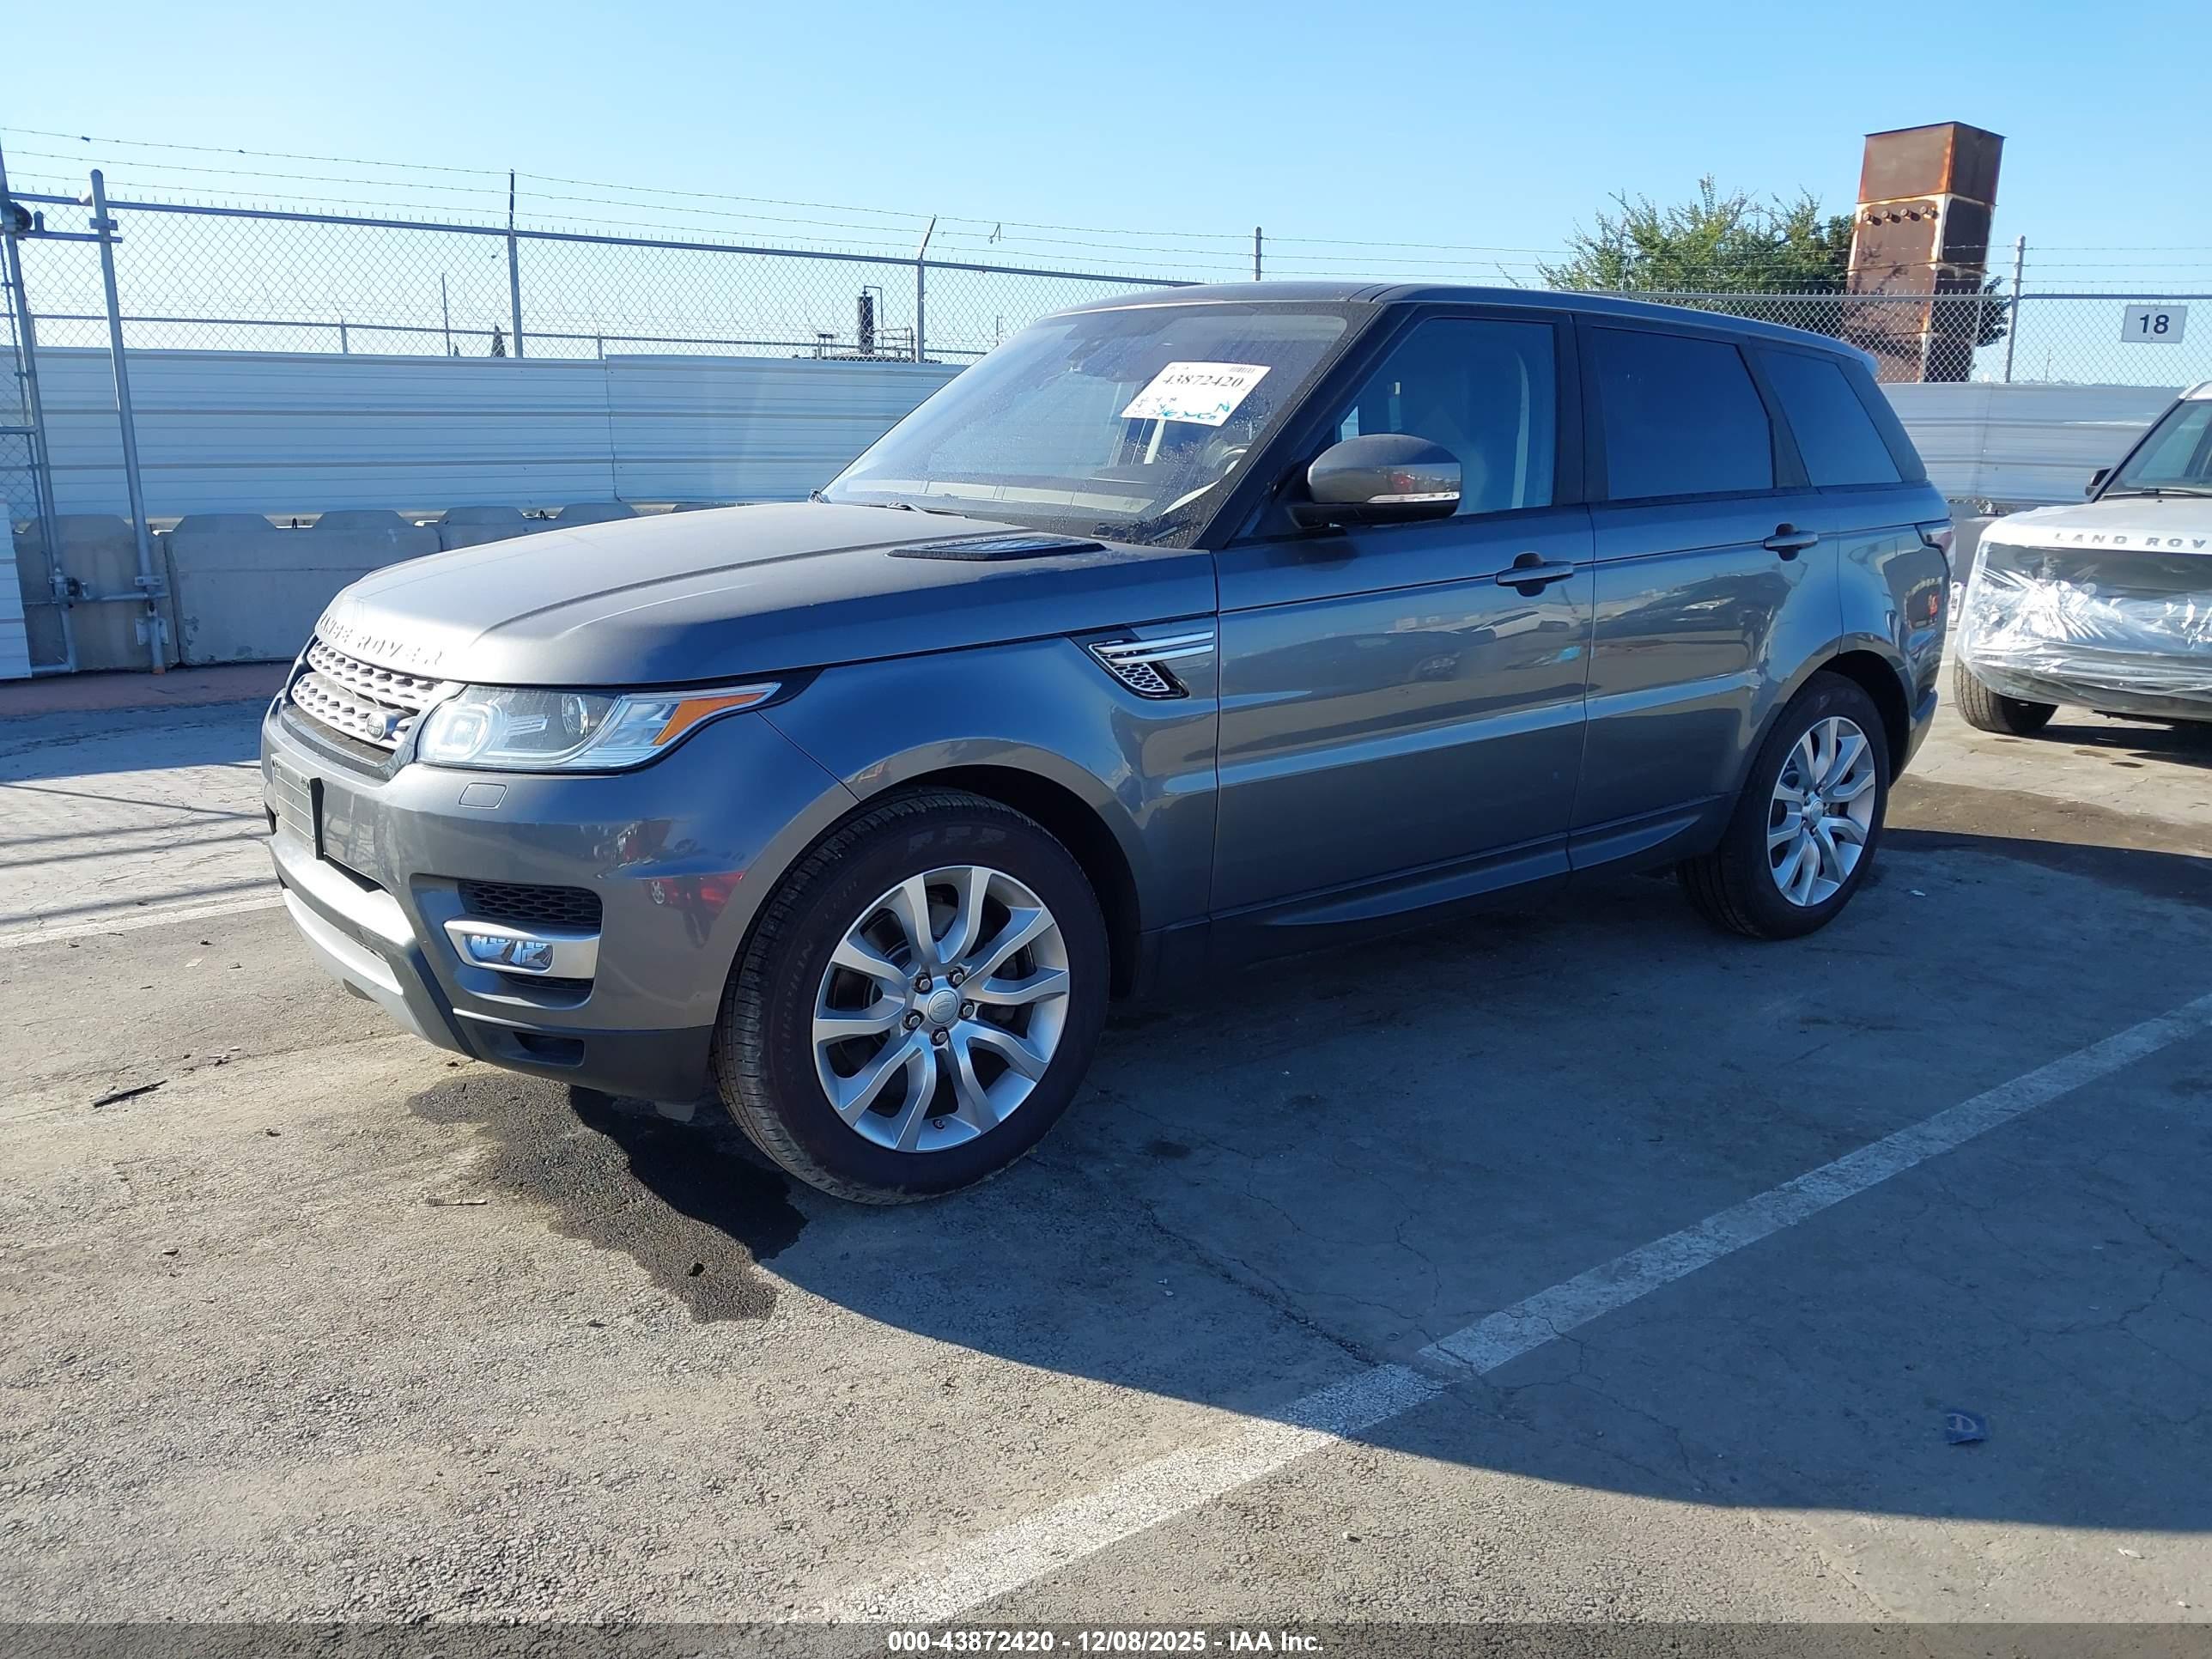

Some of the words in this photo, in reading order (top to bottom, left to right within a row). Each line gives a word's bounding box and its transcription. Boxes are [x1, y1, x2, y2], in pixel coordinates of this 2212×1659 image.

[2139, 314, 2169, 334] 18
[1163, 374, 1244, 388] 43872420
[2053, 532, 2128, 545] LAND
